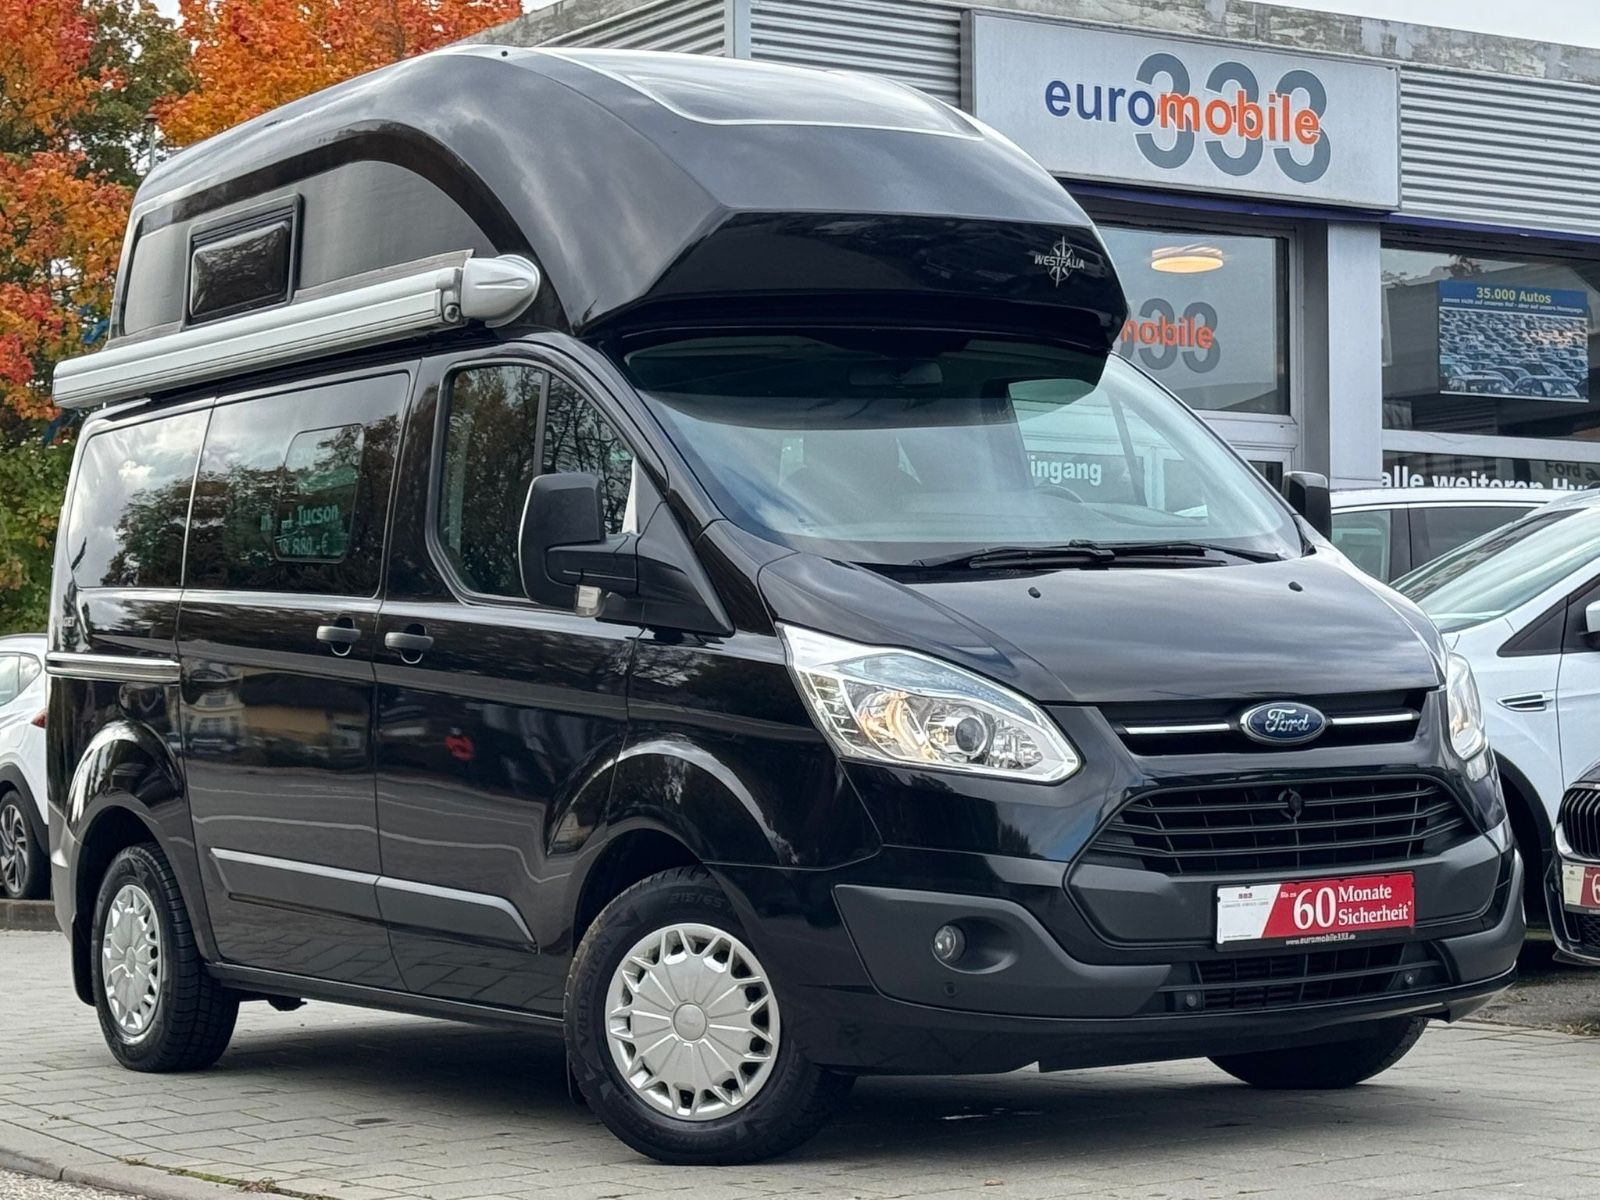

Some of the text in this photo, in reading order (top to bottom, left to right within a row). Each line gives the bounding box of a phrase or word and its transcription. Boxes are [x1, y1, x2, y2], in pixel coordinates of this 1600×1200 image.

[1045, 79, 1321, 145] euromobile
[1034, 254, 1085, 269] WESTFALIA
[1476, 287, 1516, 301] 35.000
[1519, 291, 1552, 304] Autos
[1120, 298, 1221, 374] 33
[1027, 453, 1102, 486] ingang
[297, 504, 339, 526] Tucson
[1265, 708, 1310, 732] Ford
[1338, 884, 1392, 903] Monate
[1293, 886, 1337, 930] 60
